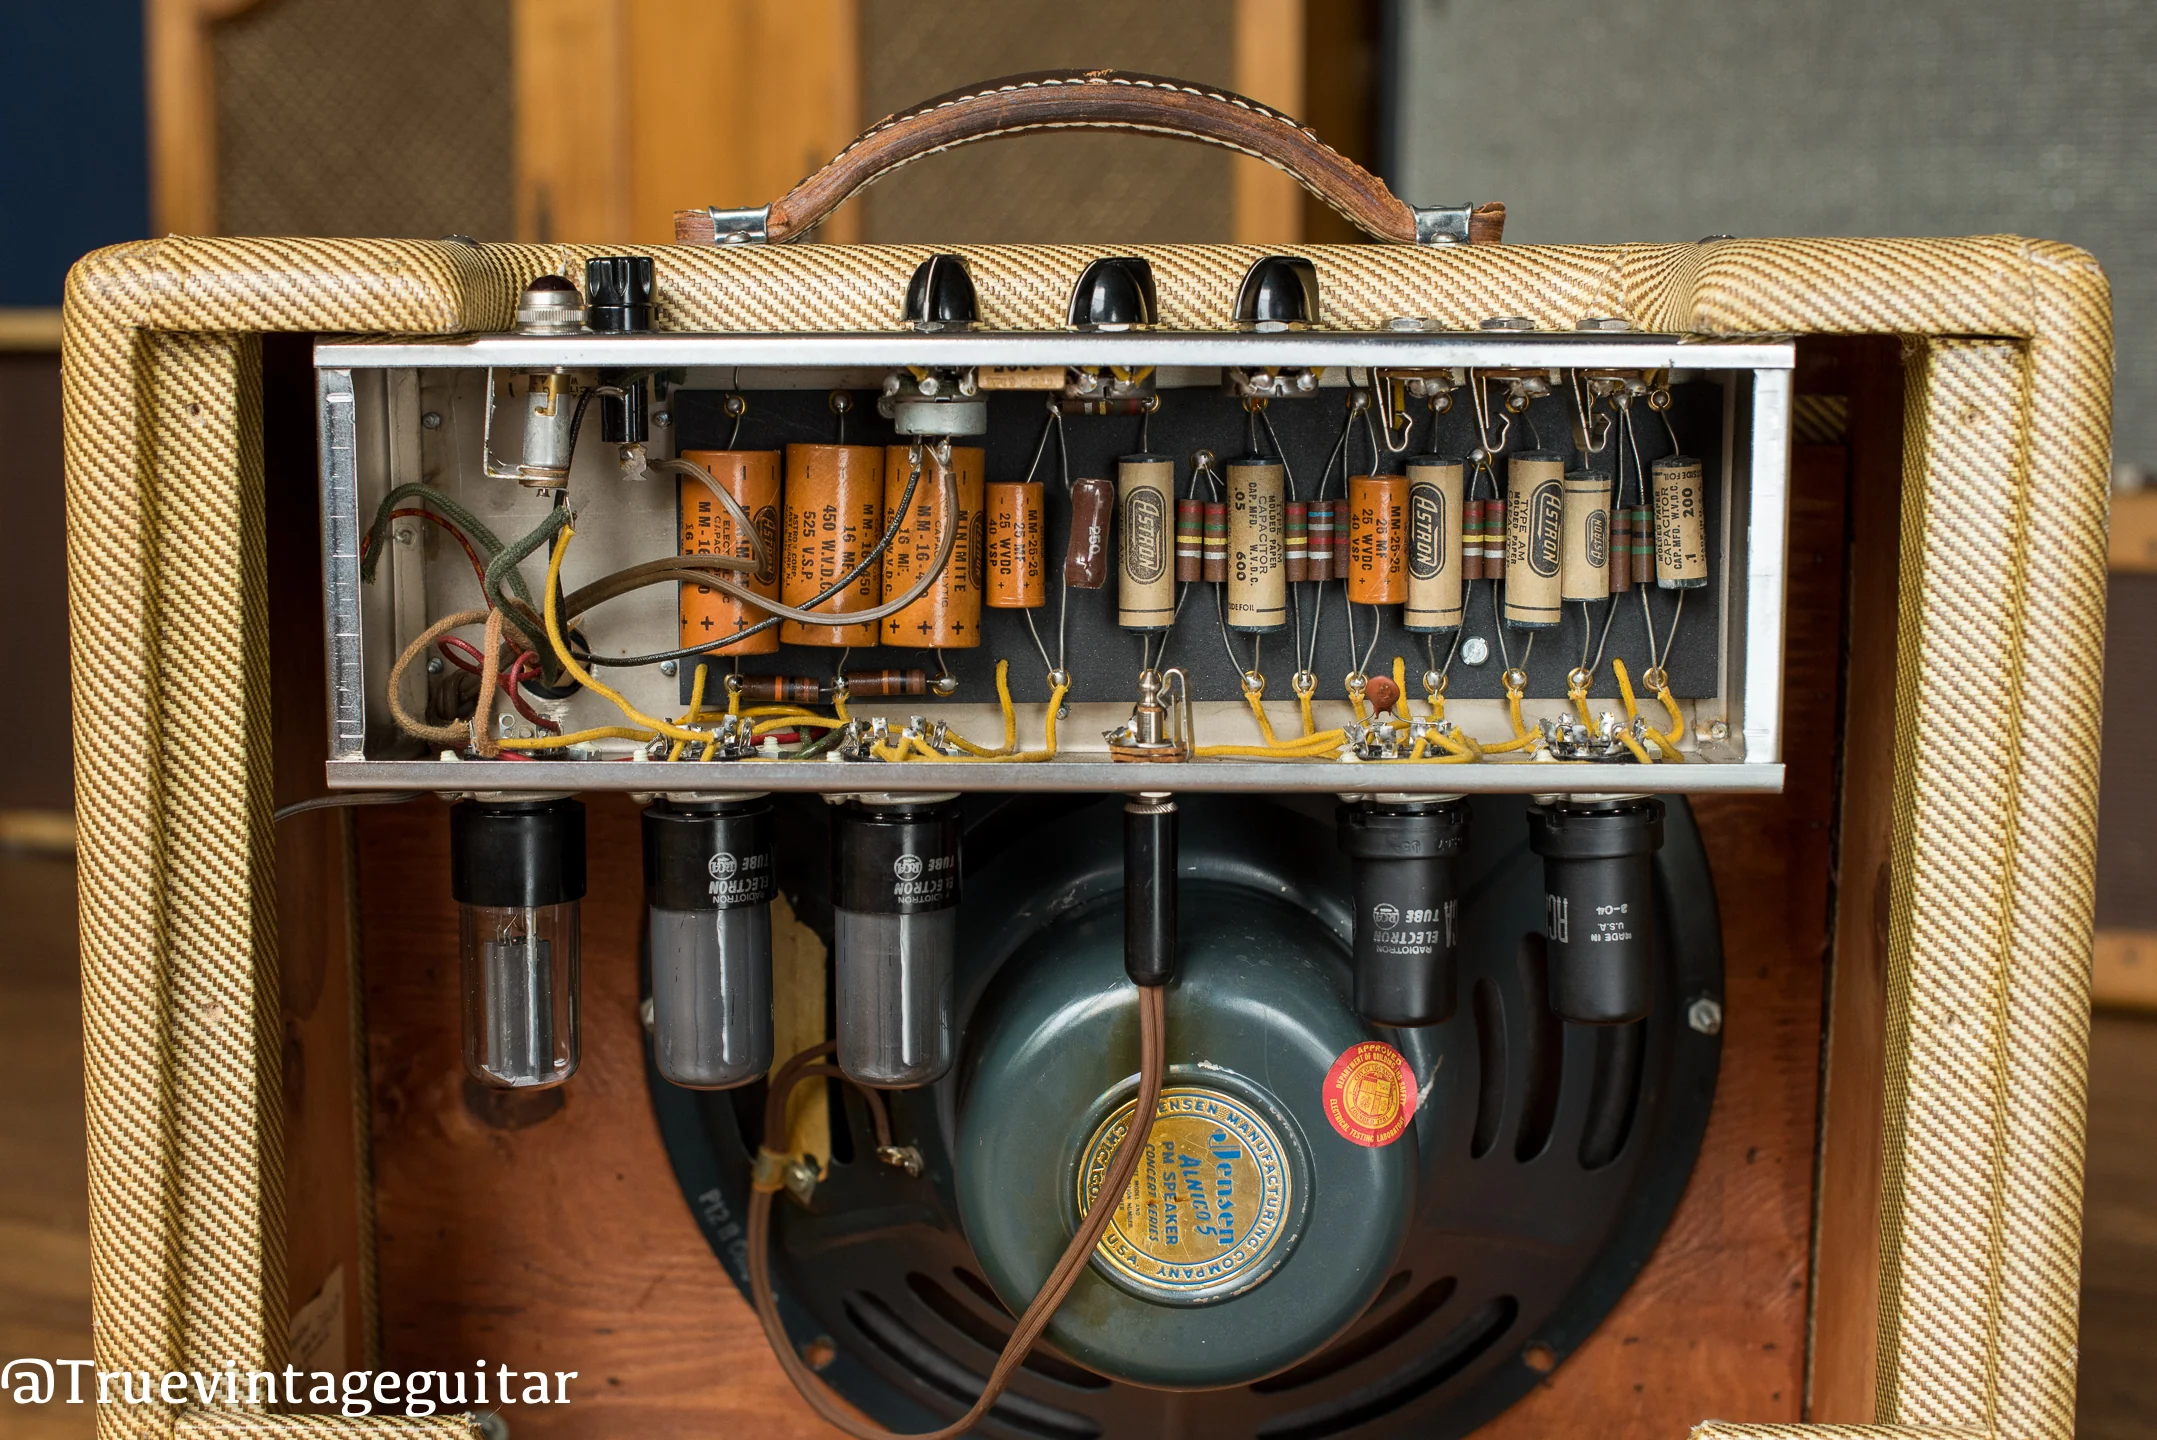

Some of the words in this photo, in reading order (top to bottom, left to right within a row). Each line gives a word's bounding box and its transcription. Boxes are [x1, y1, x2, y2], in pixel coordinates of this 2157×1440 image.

[1235, 487, 1245, 511] .05
[1670, 482, 1679, 520] W.V.D.C.
[1682, 488, 1694, 518] 200
[803, 511, 816, 537] 525
[823, 505, 836, 531] 450
[990, 519, 997, 534] 40
[1000, 513, 1010, 528] 25
[1014, 522, 1025, 537] 25
[1352, 514, 1359, 530] 40
[1362, 509, 1373, 524] 25
[1376, 519, 1387, 534] 25
[1519, 500, 1528, 533] TYPE
[1538, 493, 1561, 563] ASTRON
[1662, 487, 1672, 565] CAPACITOR
[843, 526, 856, 542] 16
[898, 528, 910, 544] 16
[1028, 510, 1038, 576] MM-25-25
[1133, 500, 1160, 570] ASTRON
[1259, 496, 1267, 574] CAPACITOR
[1390, 506, 1400, 573] MM-25-25
[1412, 496, 1438, 566] ASTRON
[1591, 519, 1605, 559] ASTRON
[954, 511, 968, 592] MINIMITE
[1000, 538, 1011, 574] WVDC
[1014, 544, 1025, 562] MF
[1277, 543, 1282, 563] AM
[1362, 534, 1372, 570] WVDC
[1376, 540, 1387, 558] MF
[1518, 541, 1526, 561] AM
[1685, 553, 1697, 564] .1
[801, 547, 814, 582] V.S.P.
[1237, 551, 1246, 581] 600
[1250, 545, 1258, 586] W.V.D.C.
[742, 853, 769, 870] TUBE
[708, 876, 769, 894] ELECTRON
[713, 891, 764, 903] RADIOTRON
[1405, 909, 1439, 923] TUBE
[1597, 922, 1624, 931] U.S.A.
[1373, 931, 1439, 944] ELECTRON
[1376, 945, 1432, 954] RADIOTRON
[1591, 934, 1601, 942] IN
[1604, 932, 1632, 941] MADE
[1358, 1045, 1402, 1065] APPROVED
[1336, 1055, 1364, 1089] DEPARTMENT
[1373, 1053, 1395, 1069] BUILDING
[1159, 1100, 1218, 1116] ENSEN
[1330, 1099, 1349, 1132] ELECTRICAL
[1350, 1129, 1374, 1142] TESTING
[1377, 1116, 1404, 1142] LABORATORY
[1162, 1141, 1175, 1164] PM
[1146, 1143, 1156, 1197] CONCERT
[1226, 1113, 1279, 1249] MANUFACTURING
[1178, 1153, 1211, 1221] ALNICO
[1197, 1225, 1218, 1236] 5
[1208, 1128, 1243, 1246] Jensen
[1163, 1172, 1178, 1245] SPEAKER
[1148, 1203, 1159, 1242] SERIES
[1156, 1251, 1245, 1279] COMPANY
